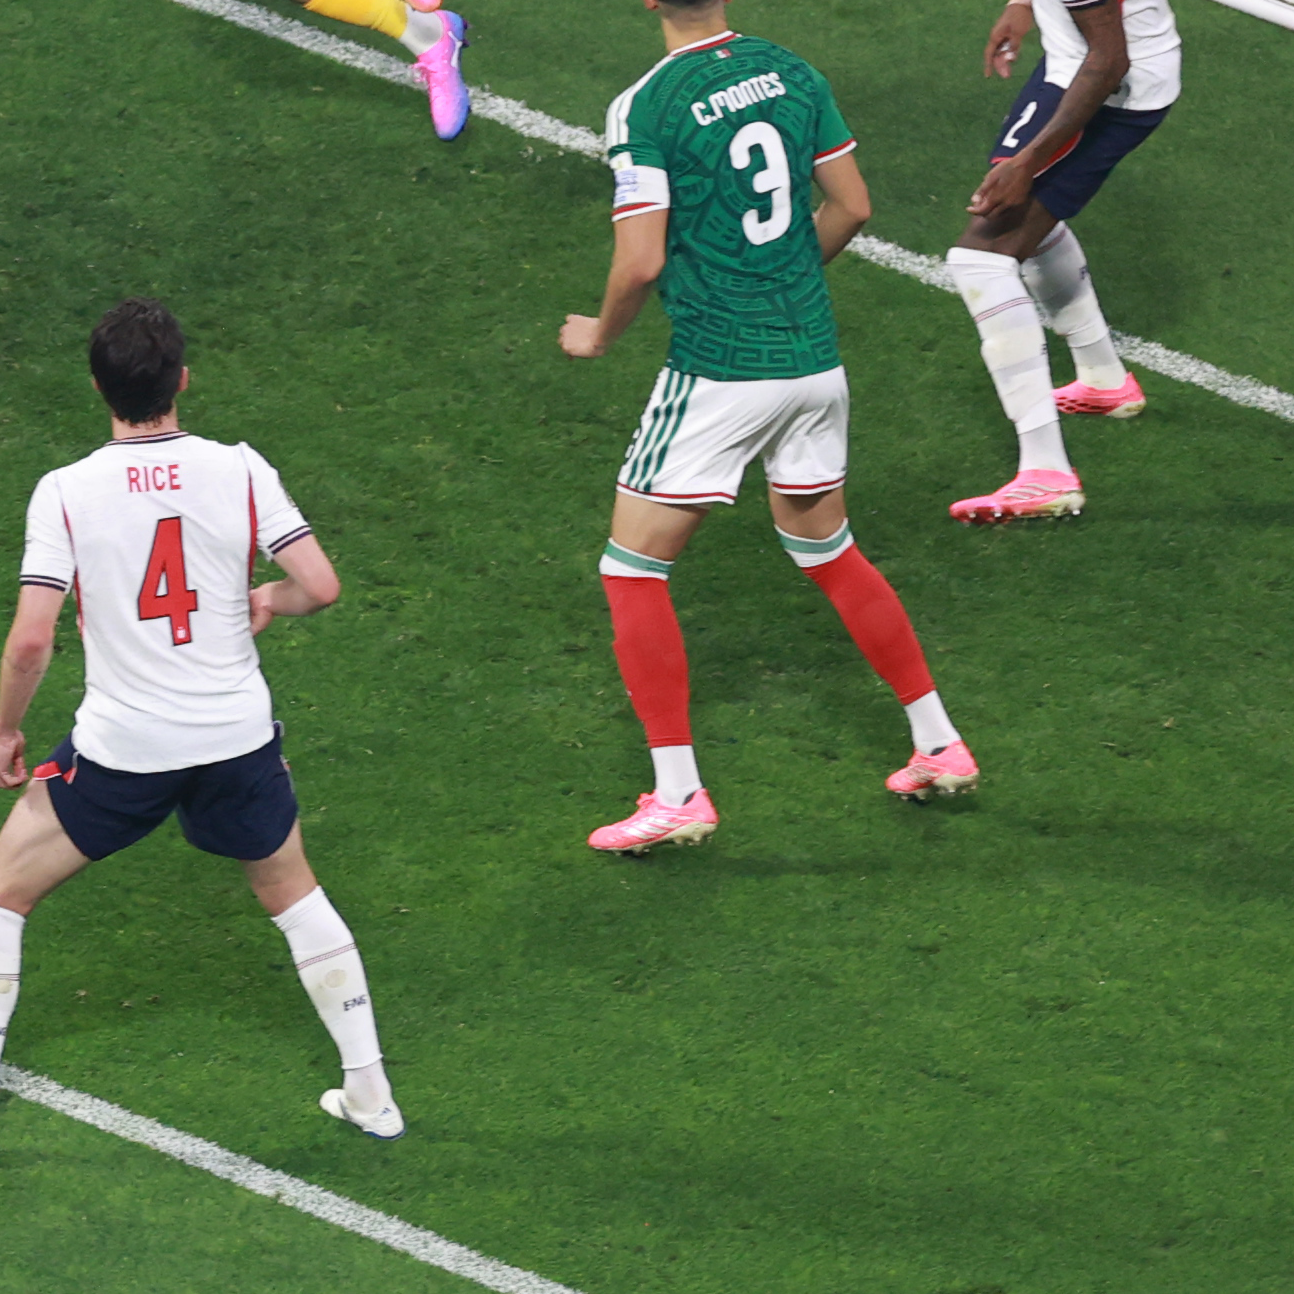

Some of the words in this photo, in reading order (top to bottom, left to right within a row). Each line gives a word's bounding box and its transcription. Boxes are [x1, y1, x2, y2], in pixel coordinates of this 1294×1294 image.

[690, 72, 786, 126] C.MONTES
[1001, 101, 1038, 149] 2
[729, 121, 793, 246] 3
[126, 464, 182, 494] RICE
[137, 515, 199, 646] 4
